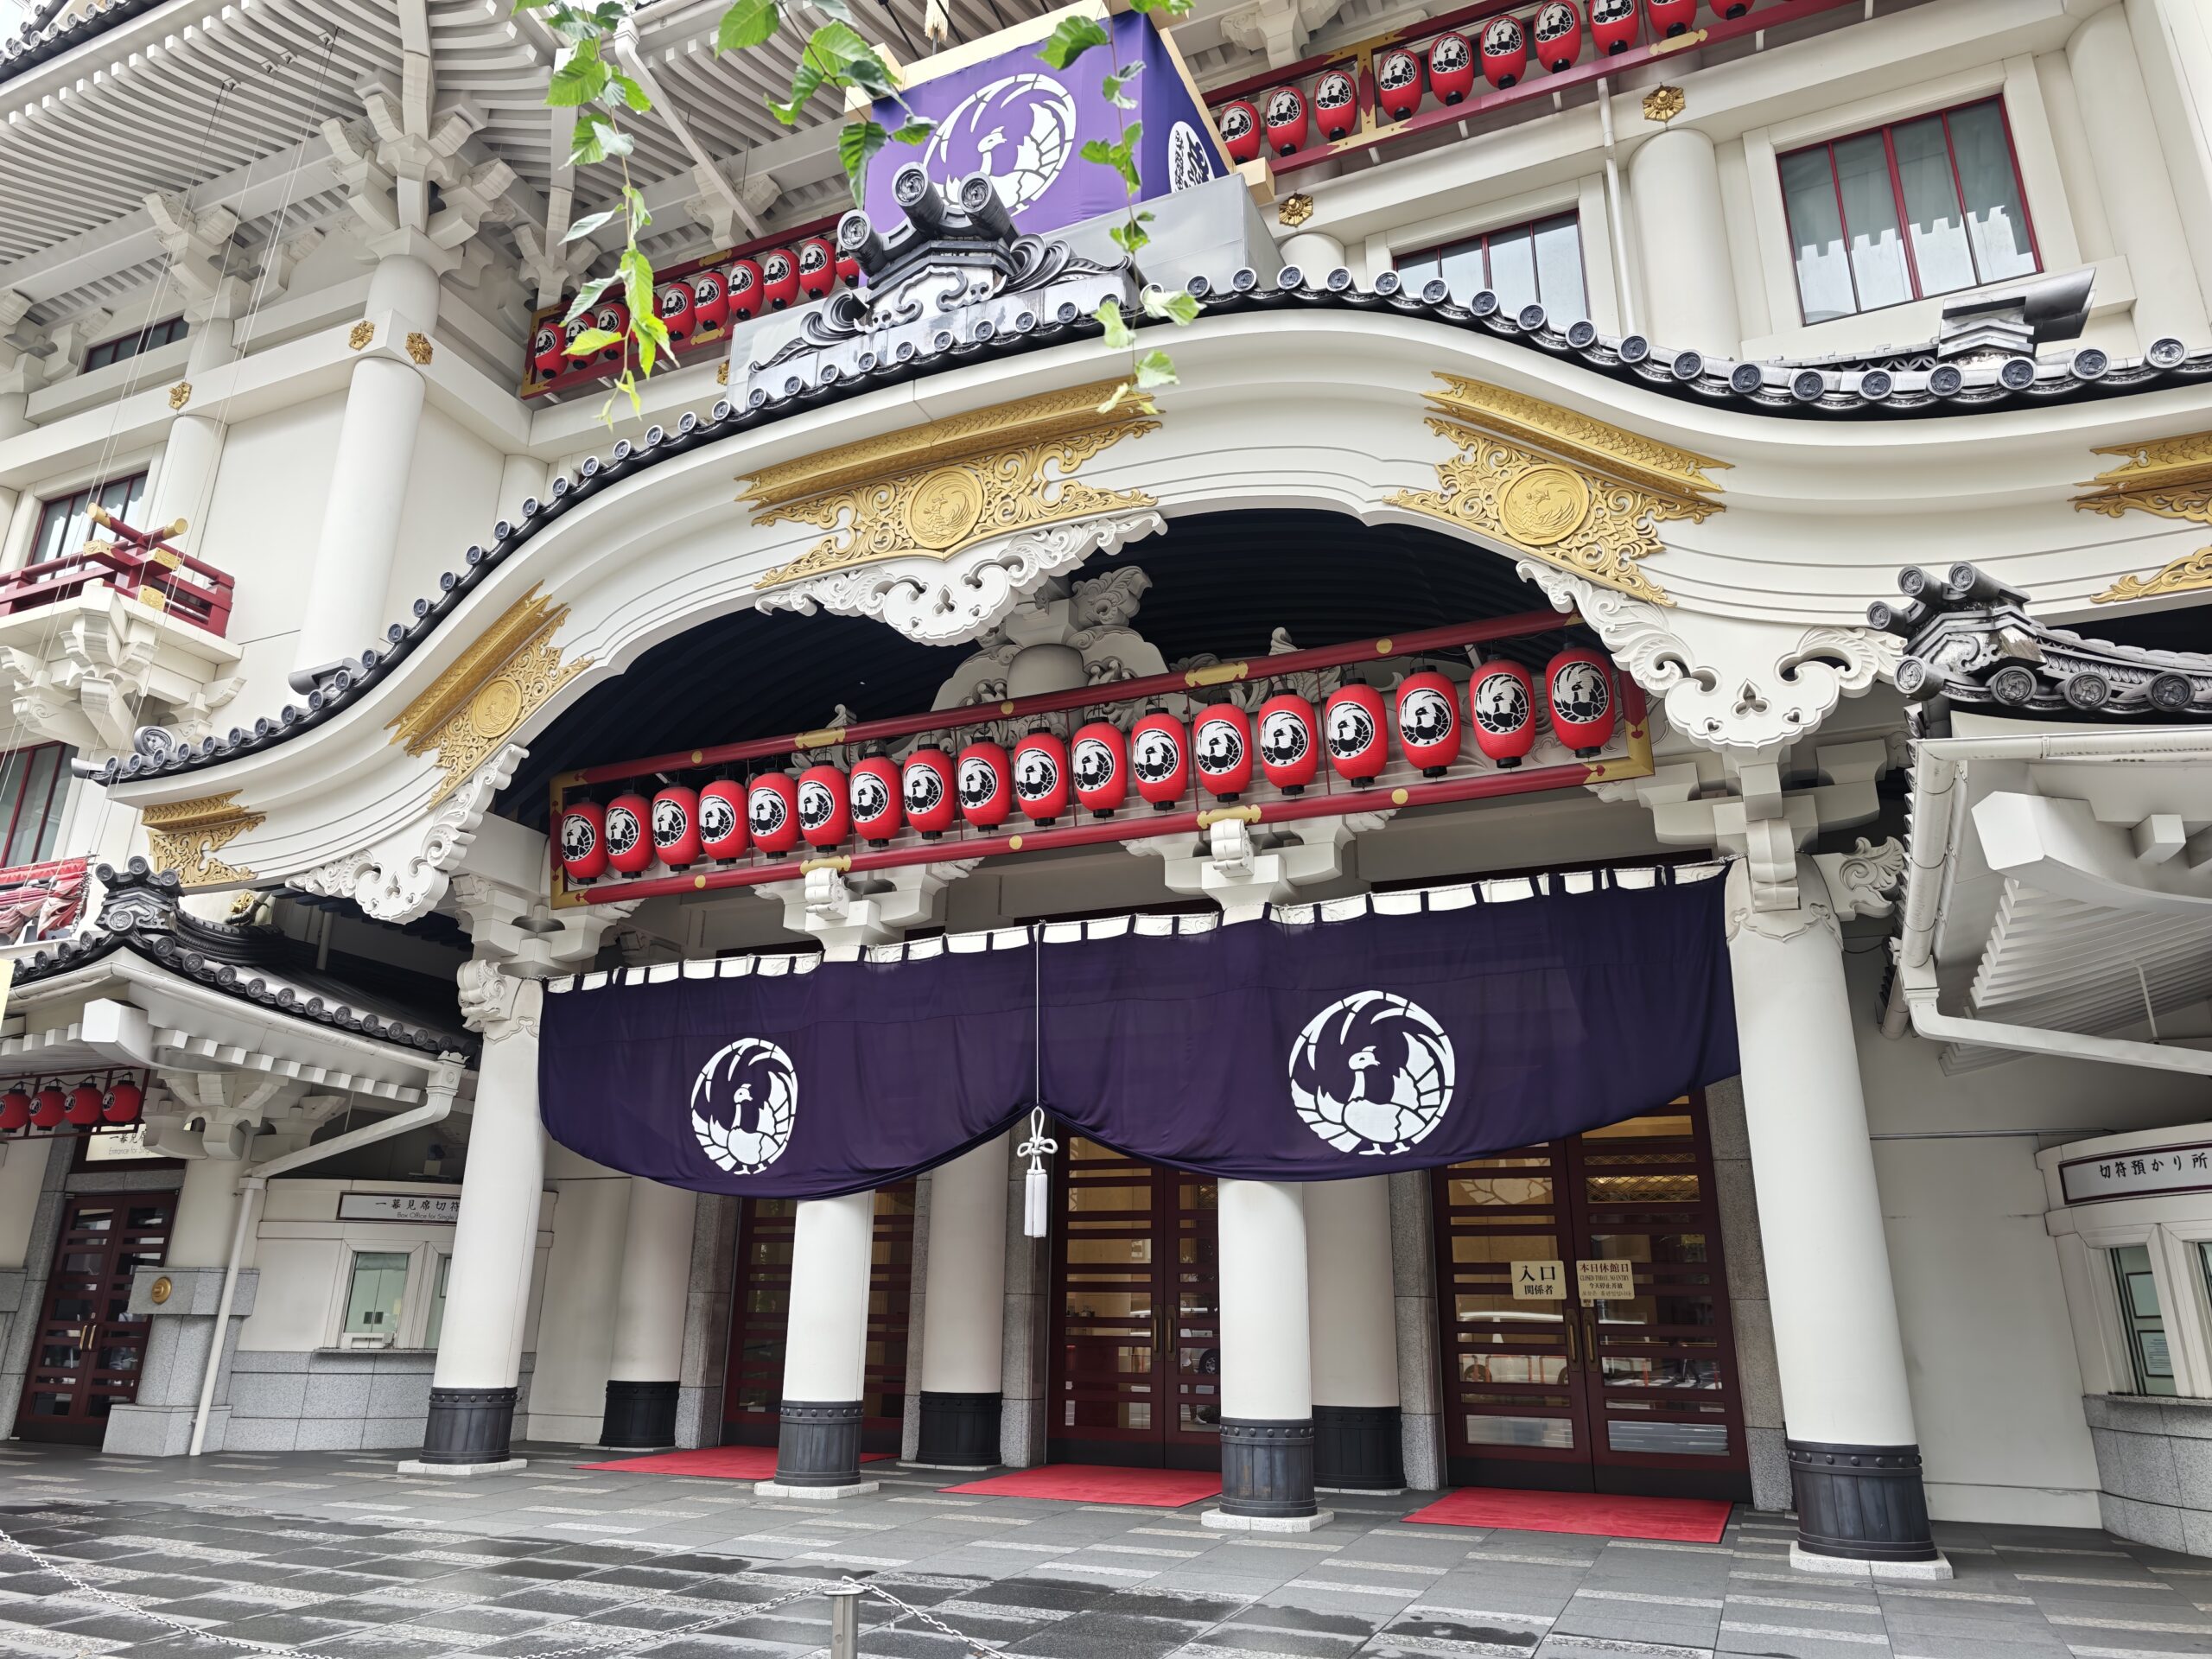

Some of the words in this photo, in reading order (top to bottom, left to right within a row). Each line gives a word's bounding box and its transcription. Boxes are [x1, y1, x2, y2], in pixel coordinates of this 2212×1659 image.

[2100, 1152, 2208, 1179] 切符預かり所
[437, 1213, 454, 1222] Single
[1580, 1262, 1629, 1273] 本日休館日
[1519, 1265, 1555, 1282] 入口
[1524, 1284, 1554, 1295] 関係者
